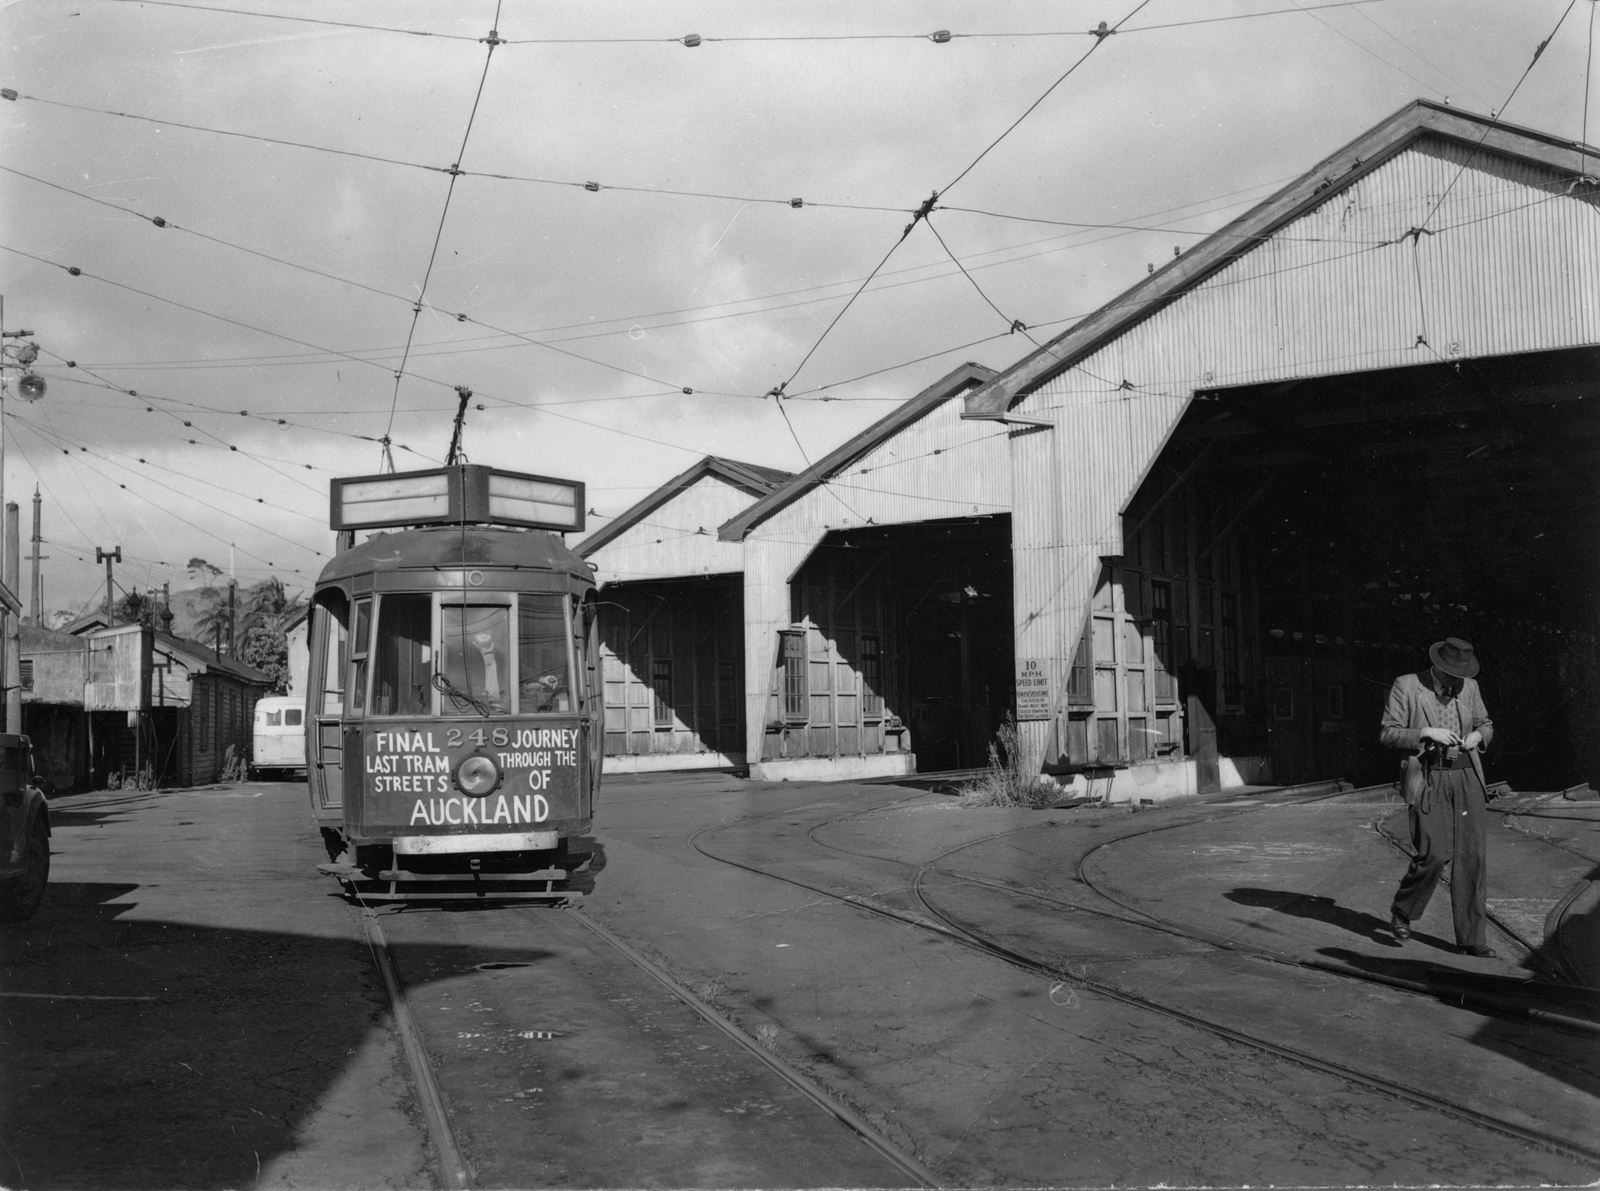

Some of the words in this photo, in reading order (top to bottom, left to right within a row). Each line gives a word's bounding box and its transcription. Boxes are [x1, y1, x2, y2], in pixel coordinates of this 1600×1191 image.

[1452, 342, 1460, 352] 2
[1025, 661, 1037, 670] 10
[1016, 679, 1032, 687] SPEED
[1033, 678, 1048, 686] LIMIT
[376, 732, 440, 752] FINAL
[511, 729, 579, 748] JOURNEY
[446, 727, 512, 748] 248
[366, 755, 399, 773] LAST
[403, 755, 450, 773] TRAM
[497, 751, 551, 768] THROUGH
[554, 750, 577, 767] THE
[374, 775, 448, 792] STREETS
[529, 770, 552, 790] OF
[409, 794, 550, 826] AUCKLAND
